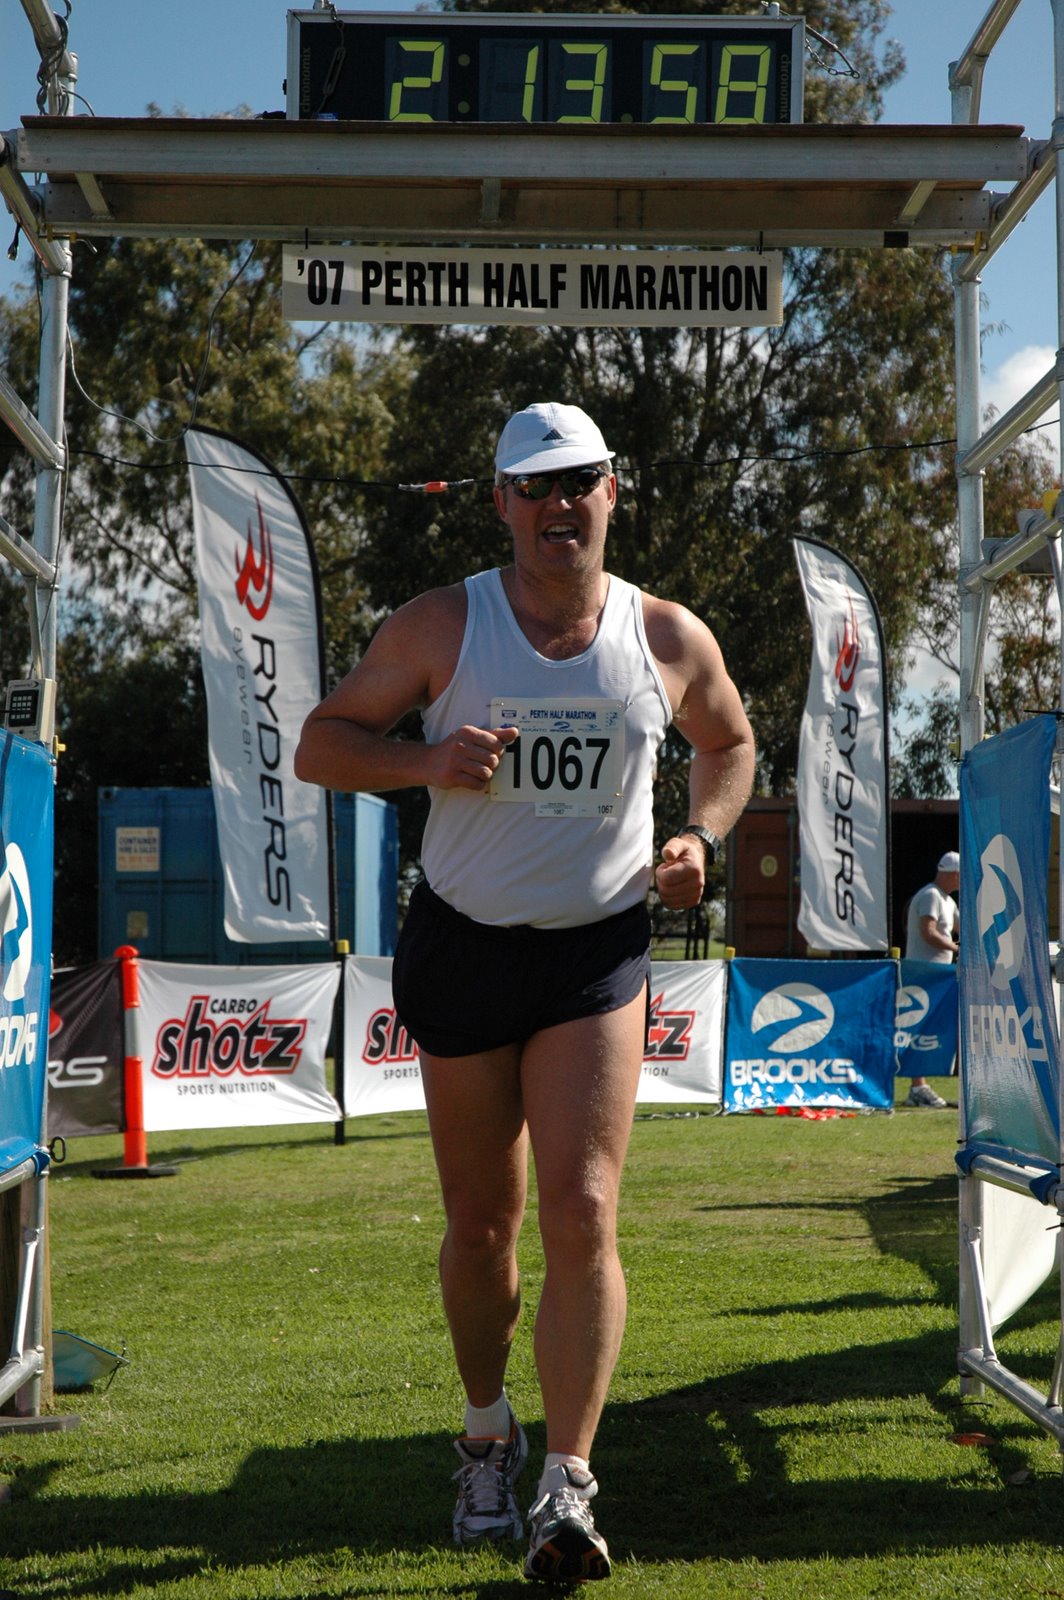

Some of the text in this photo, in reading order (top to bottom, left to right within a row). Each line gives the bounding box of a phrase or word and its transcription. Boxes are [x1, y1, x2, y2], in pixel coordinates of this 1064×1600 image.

[297, 259, 768, 311] '07 PERTH HALF MARATHON
[231, 627, 252, 765] eyewear
[530, 710, 597, 720] PERTH HALF MARATHON
[252, 634, 291, 912] RYDERS
[506, 736, 611, 790] 1067
[821, 711, 836, 805] yewear
[597, 804, 614, 814] 1067
[835, 702, 859, 926] RYDERS
[210, 999, 258, 1014] CARBO
[153, 998, 305, 1076] shotz
[177, 1082, 277, 1096] SPORTS NUTRITION
[383, 1067, 420, 1080] SPORTS
[730, 1058, 857, 1087] BROOKS
